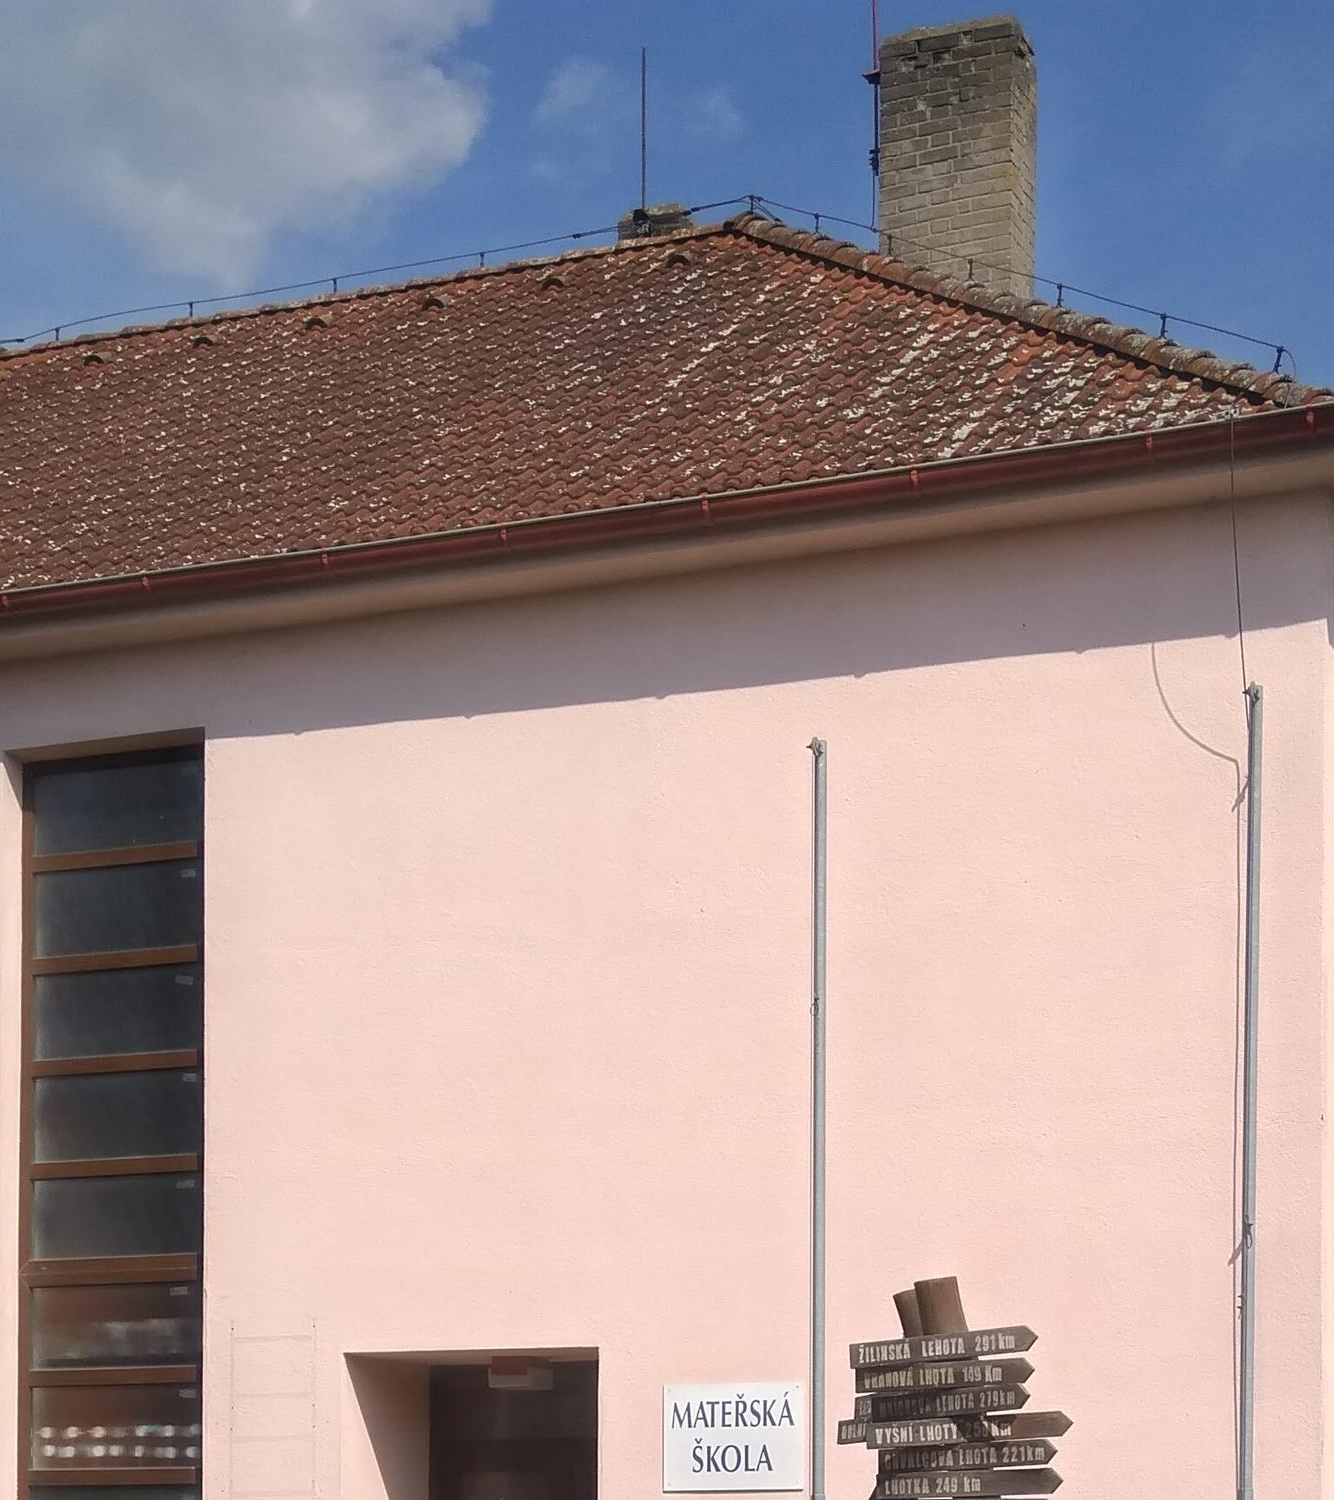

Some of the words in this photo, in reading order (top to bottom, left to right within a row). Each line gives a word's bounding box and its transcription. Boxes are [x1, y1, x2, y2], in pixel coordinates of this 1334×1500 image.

[858, 1339, 911, 1364] ŽILINSKÁ
[921, 1337, 965, 1358] LEHOTA
[920, 1366, 955, 1386] LHOTA
[963, 1366, 982, 1382] 149
[671, 1391, 795, 1429] MATEŘSKÁ
[936, 1391, 975, 1412] LEHOTA
[875, 1423, 914, 1445] VYŠNÍ
[919, 1423, 958, 1442] LHOTY
[692, 1437, 773, 1473] ŠKOLA
[958, 1447, 997, 1466] LHOTA
[885, 1478, 930, 1495] LHOTKA
[936, 1477, 958, 1494] 249
